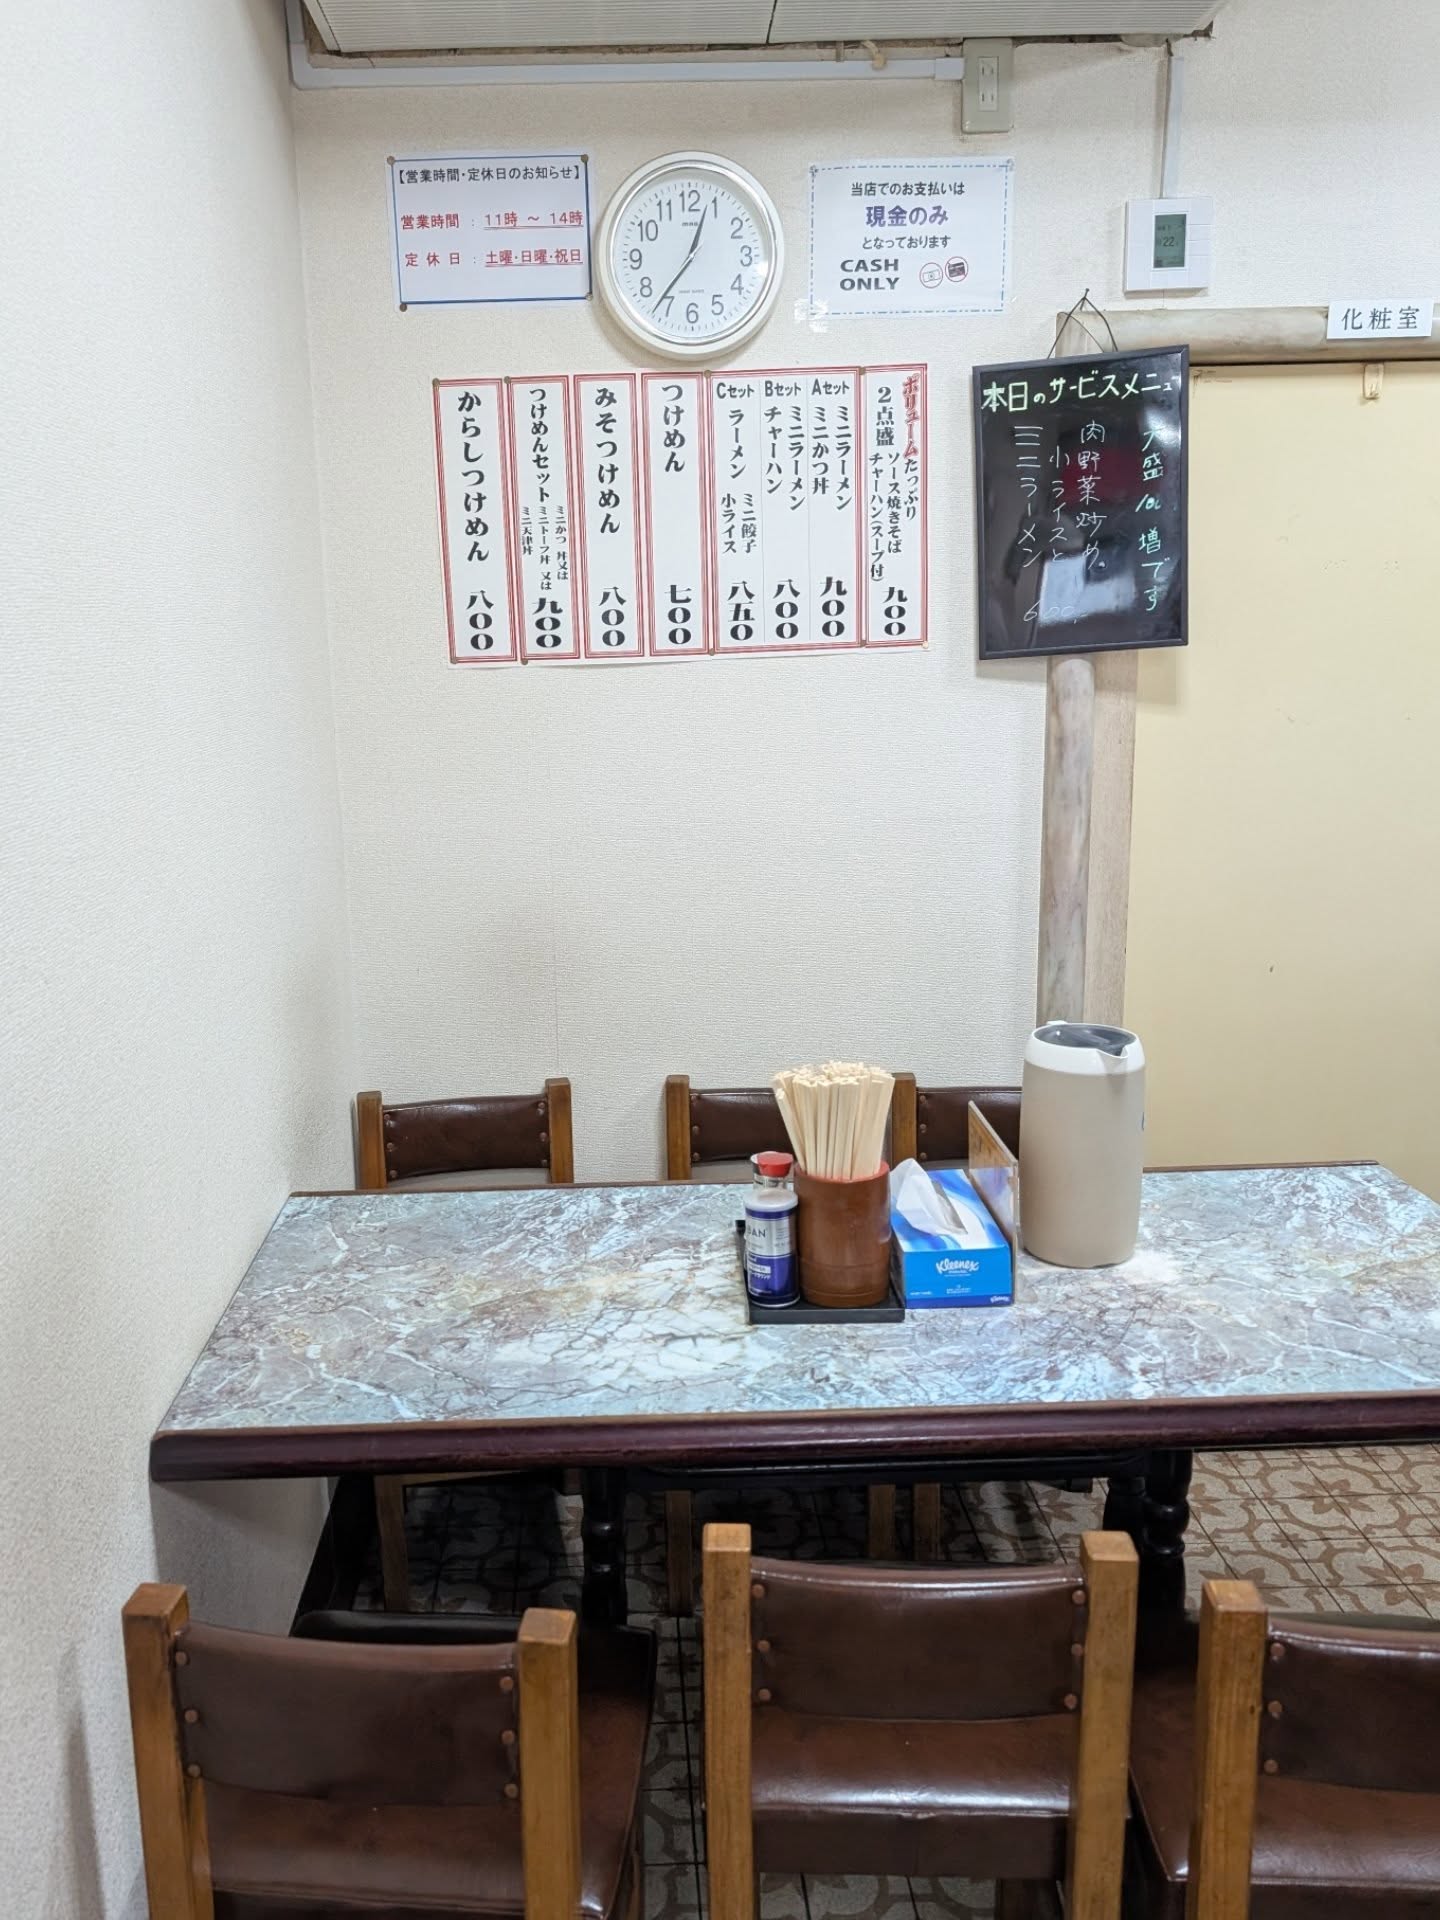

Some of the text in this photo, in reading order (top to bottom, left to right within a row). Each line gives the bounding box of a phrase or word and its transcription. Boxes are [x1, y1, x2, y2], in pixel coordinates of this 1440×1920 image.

[398, 164, 581, 185] 【営業時間・定休日のお知らせ】
[851, 181, 965, 197] 当店でのお支払いは
[656, 199, 672, 221] 11
[679, 189, 700, 212] 12
[712, 196, 717, 219] 1
[400, 213, 460, 230] 営業時間
[484, 211, 518, 227] 11時
[549, 209, 583, 226] 14時
[865, 205, 949, 228] 現金のみ
[638, 219, 658, 242] 10
[730, 217, 743, 239] 2
[862, 235, 951, 250] となっております
[1162, 236, 1175, 247] 22
[629, 248, 642, 270] 9
[740, 245, 753, 267] 3
[840, 258, 899, 273] CASH
[640, 276, 652, 298] 8
[730, 273, 744, 295] 4
[839, 277, 900, 292] ONLY
[663, 296, 675, 317] 7
[686, 303, 699, 324] 6
[711, 294, 724, 316] 5
[1341, 305, 1420, 332] 化粧室
[716, 382, 755, 400] Cセット
[764, 380, 802, 398] Bセット
[811, 378, 850, 396] Aセット
[876, 386, 895, 447] 2点盛
[661, 384, 686, 473] つけめん
[529, 388, 551, 503] つけめんセット
[728, 408, 746, 479] ラーメン
[764, 406, 783, 494] チャーハン
[811, 406, 829, 495] ミニかつ丼
[595, 387, 621, 534] みそつけめん
[788, 405, 806, 511] ミニラーメン
[835, 405, 852, 511] ミニラーメン
[457, 391, 490, 562] からしつけめん
[887, 452, 902, 554] ソース焼きそば
[1014, 425, 1044, 568] ミニラーメン
[721, 493, 737, 554] 小ライス
[741, 494, 757, 554] ミニ餃子
[935, 1258, 980, 1274] Kleenex
